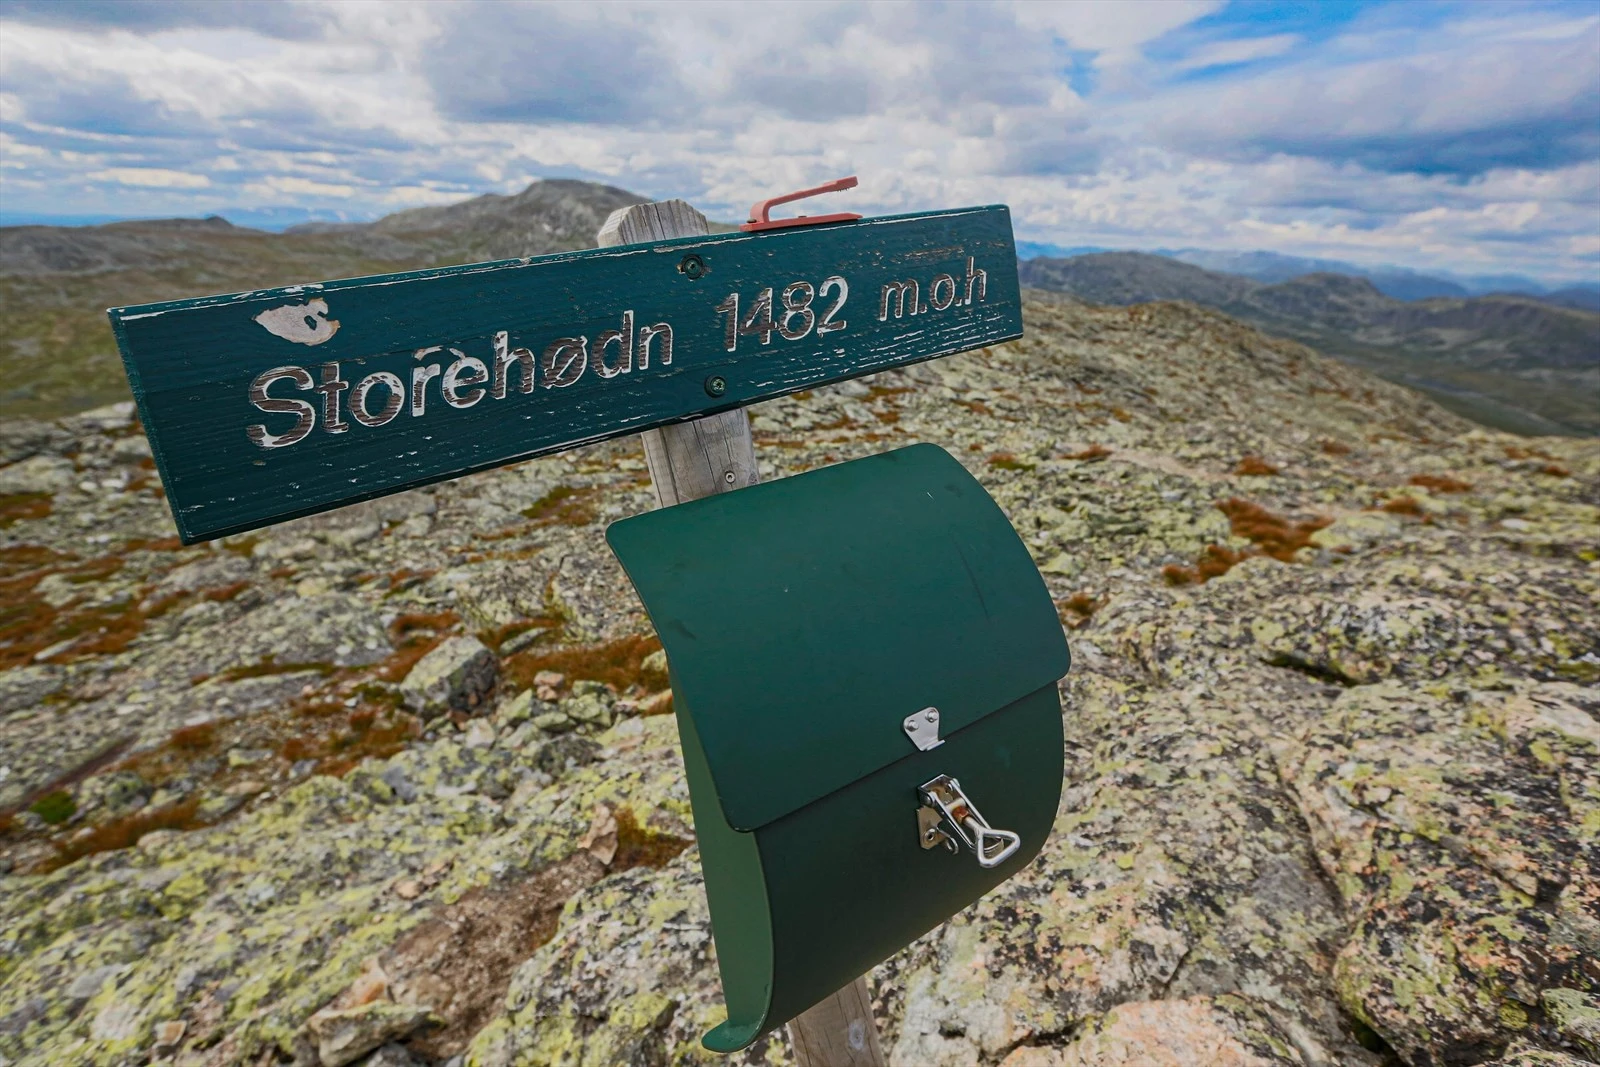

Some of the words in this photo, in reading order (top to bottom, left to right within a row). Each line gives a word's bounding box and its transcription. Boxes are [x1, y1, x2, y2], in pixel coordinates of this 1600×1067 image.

[247, 310, 674, 448] Storehødn
[714, 275, 849, 352] 1482
[879, 256, 987, 321] m.o.h
